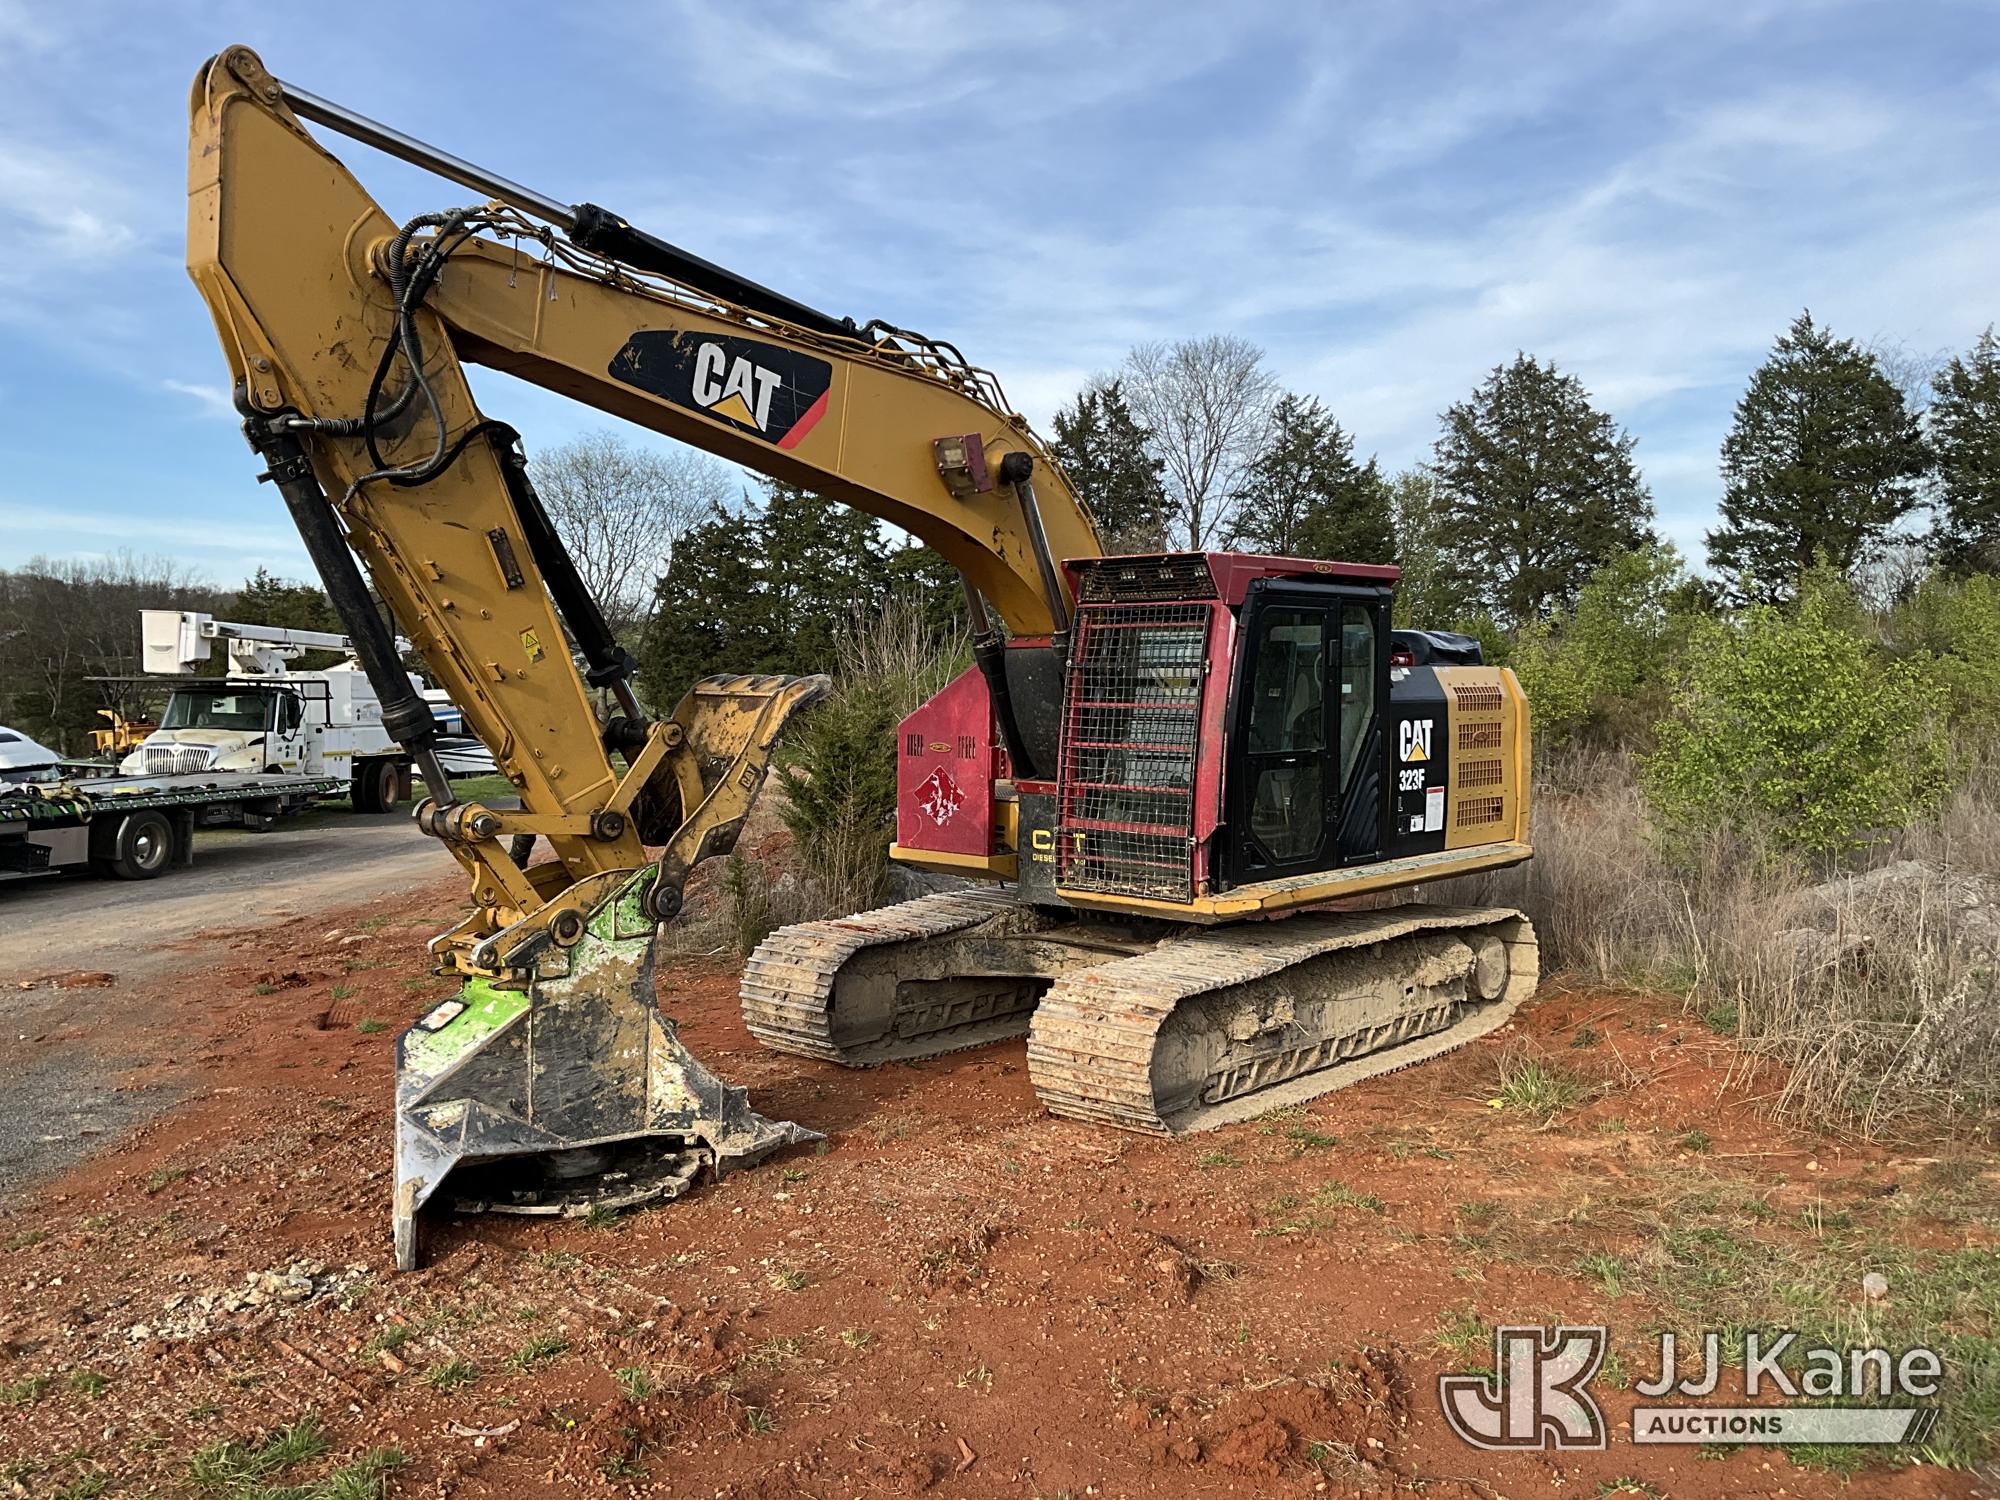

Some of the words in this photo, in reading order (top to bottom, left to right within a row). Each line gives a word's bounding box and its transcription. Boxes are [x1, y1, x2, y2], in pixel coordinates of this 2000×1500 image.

[692, 342, 781, 433] CAT
[1400, 719, 1433, 762] CAT
[1399, 768, 1425, 791] 323F
[1032, 829, 1086, 853] CT
